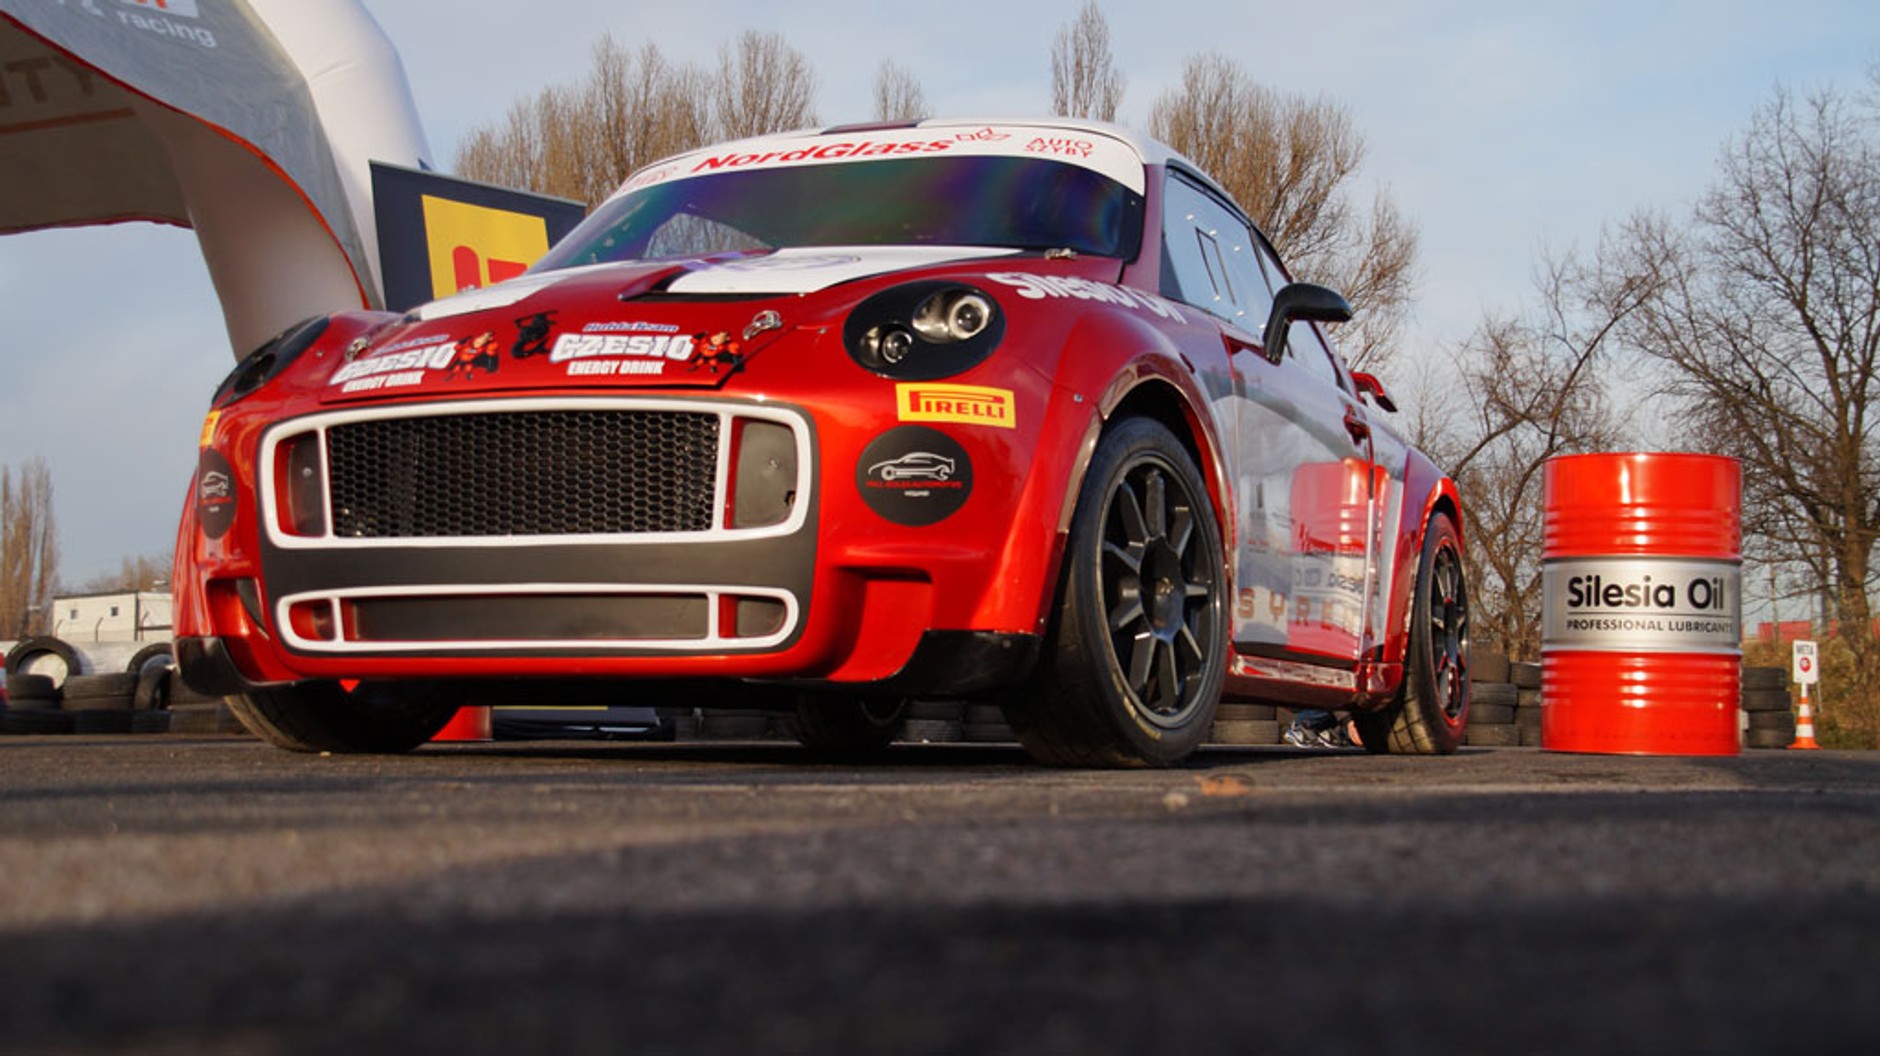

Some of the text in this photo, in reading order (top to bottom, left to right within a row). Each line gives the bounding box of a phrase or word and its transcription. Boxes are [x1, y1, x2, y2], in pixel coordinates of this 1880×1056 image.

[116, 10, 218, 48] racing
[691, 139, 954, 173] NordGlass
[1029, 137, 1094, 150] AUTO
[550, 332, 695, 363] CZESIO
[567, 360, 665, 376] ENERGY DRINK
[908, 389, 1006, 419] PIRELLI
[1567, 574, 1725, 610] Silesia Oil
[1566, 618, 1664, 632] PROFESSIONAL
